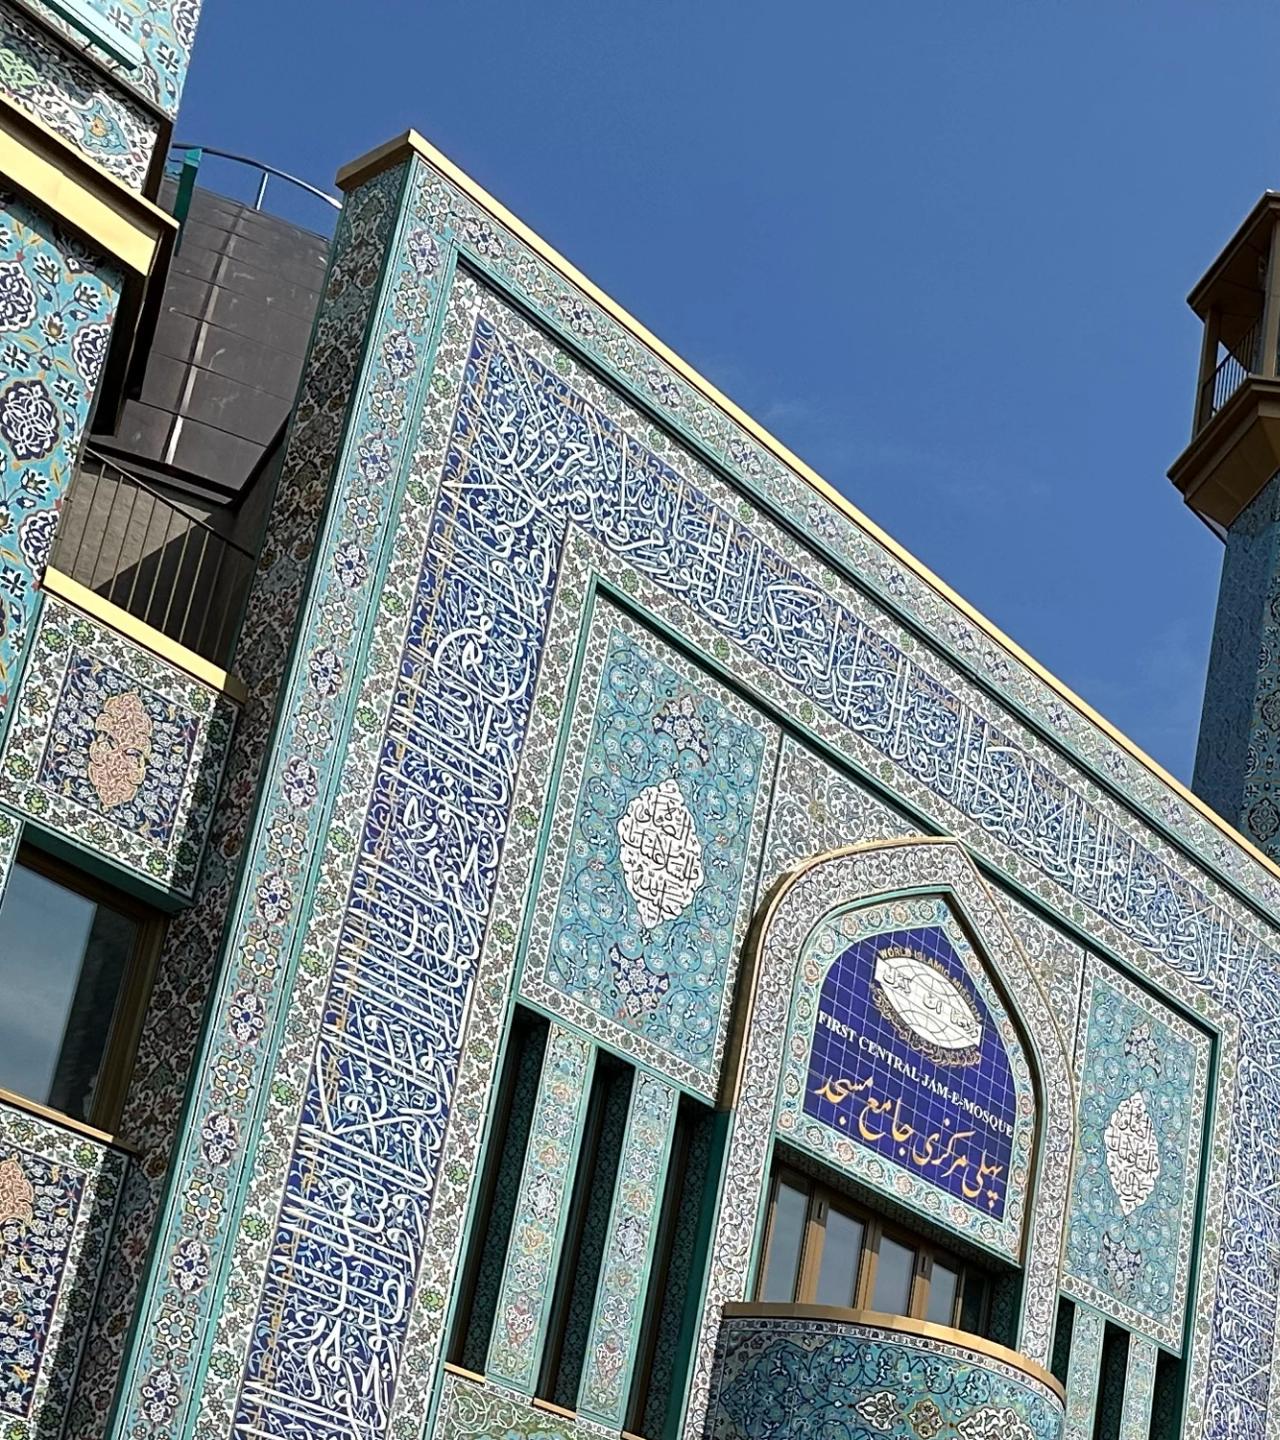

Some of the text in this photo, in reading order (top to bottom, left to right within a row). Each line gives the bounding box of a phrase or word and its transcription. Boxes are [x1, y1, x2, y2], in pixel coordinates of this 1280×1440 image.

[879, 946, 982, 1022] WORLD ISLAMIC MISSION
[818, 1012, 857, 1043] FIRST
[858, 1035, 921, 1081] CENTRAL
[921, 1075, 1014, 1138] JAM-E-MOSQUE
